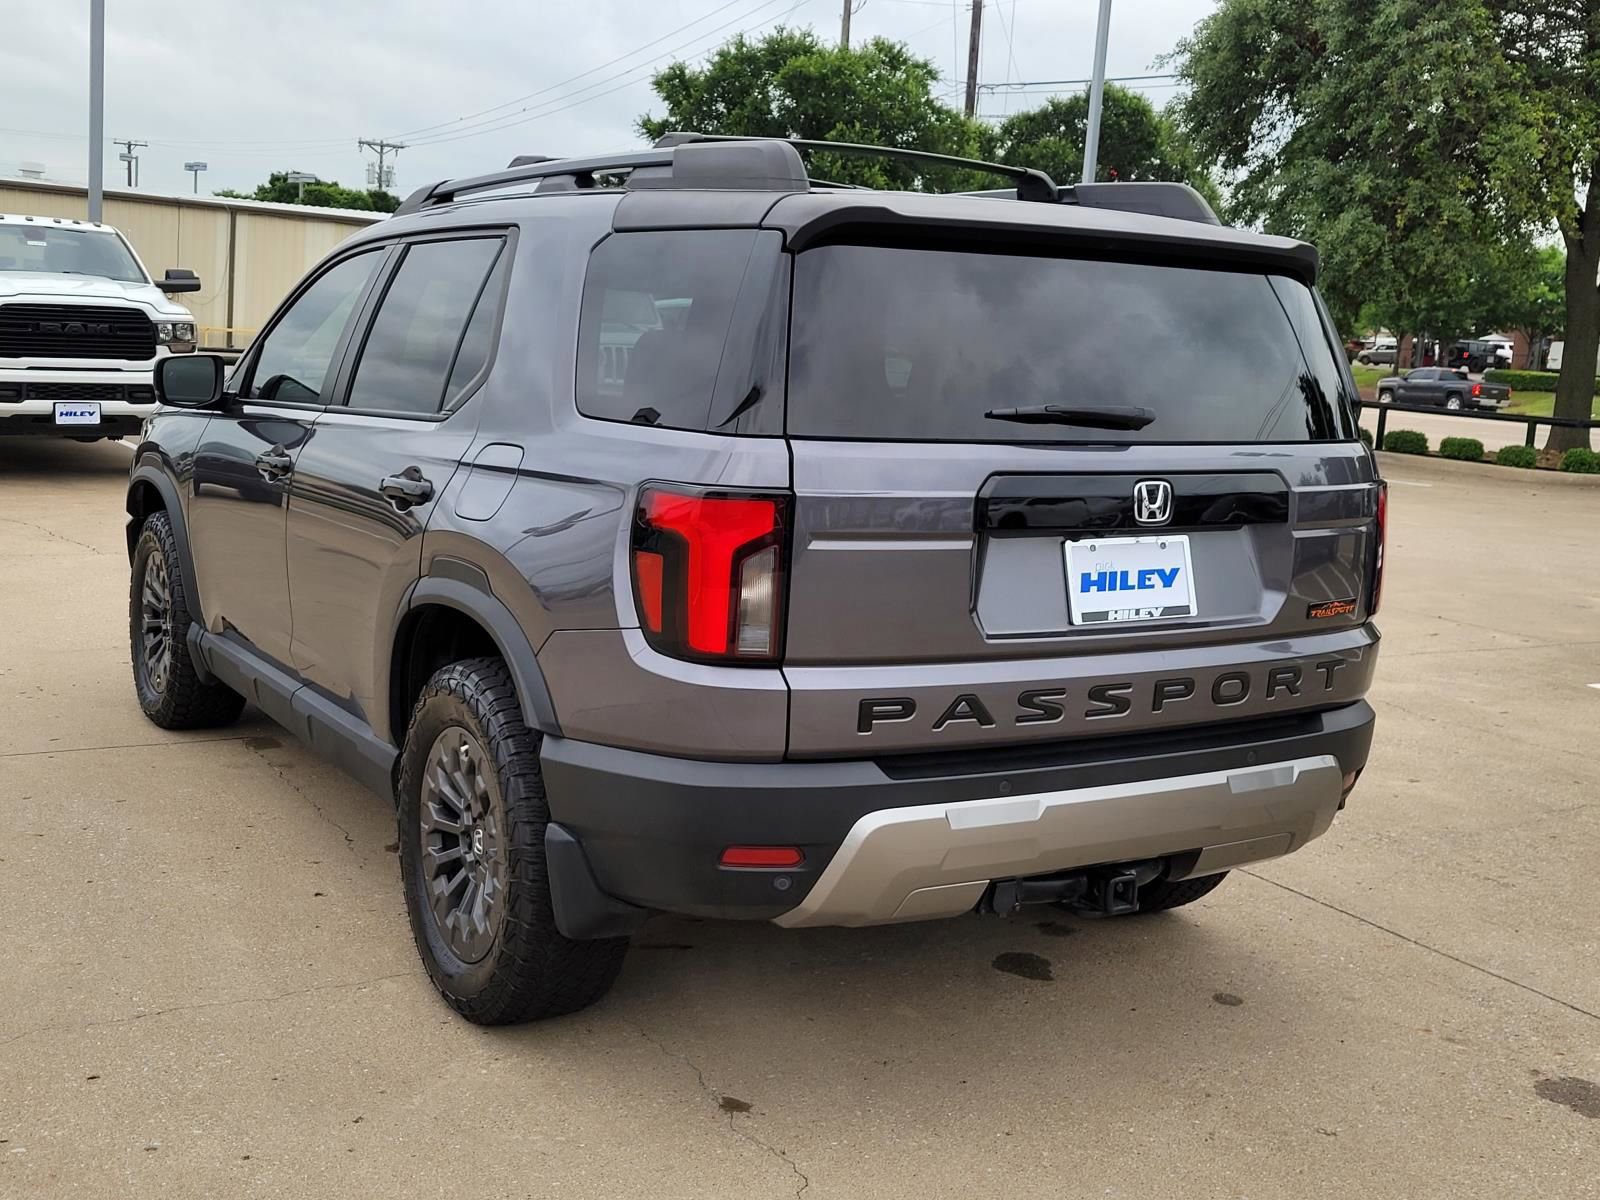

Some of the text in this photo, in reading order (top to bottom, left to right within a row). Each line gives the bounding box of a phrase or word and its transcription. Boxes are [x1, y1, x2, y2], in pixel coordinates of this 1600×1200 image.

[1080, 567, 1180, 593] HILEY
[1108, 607, 1164, 621] HILEY
[1311, 605, 1355, 618] TRAILSPORT
[857, 659, 1346, 735] PASSPORT
